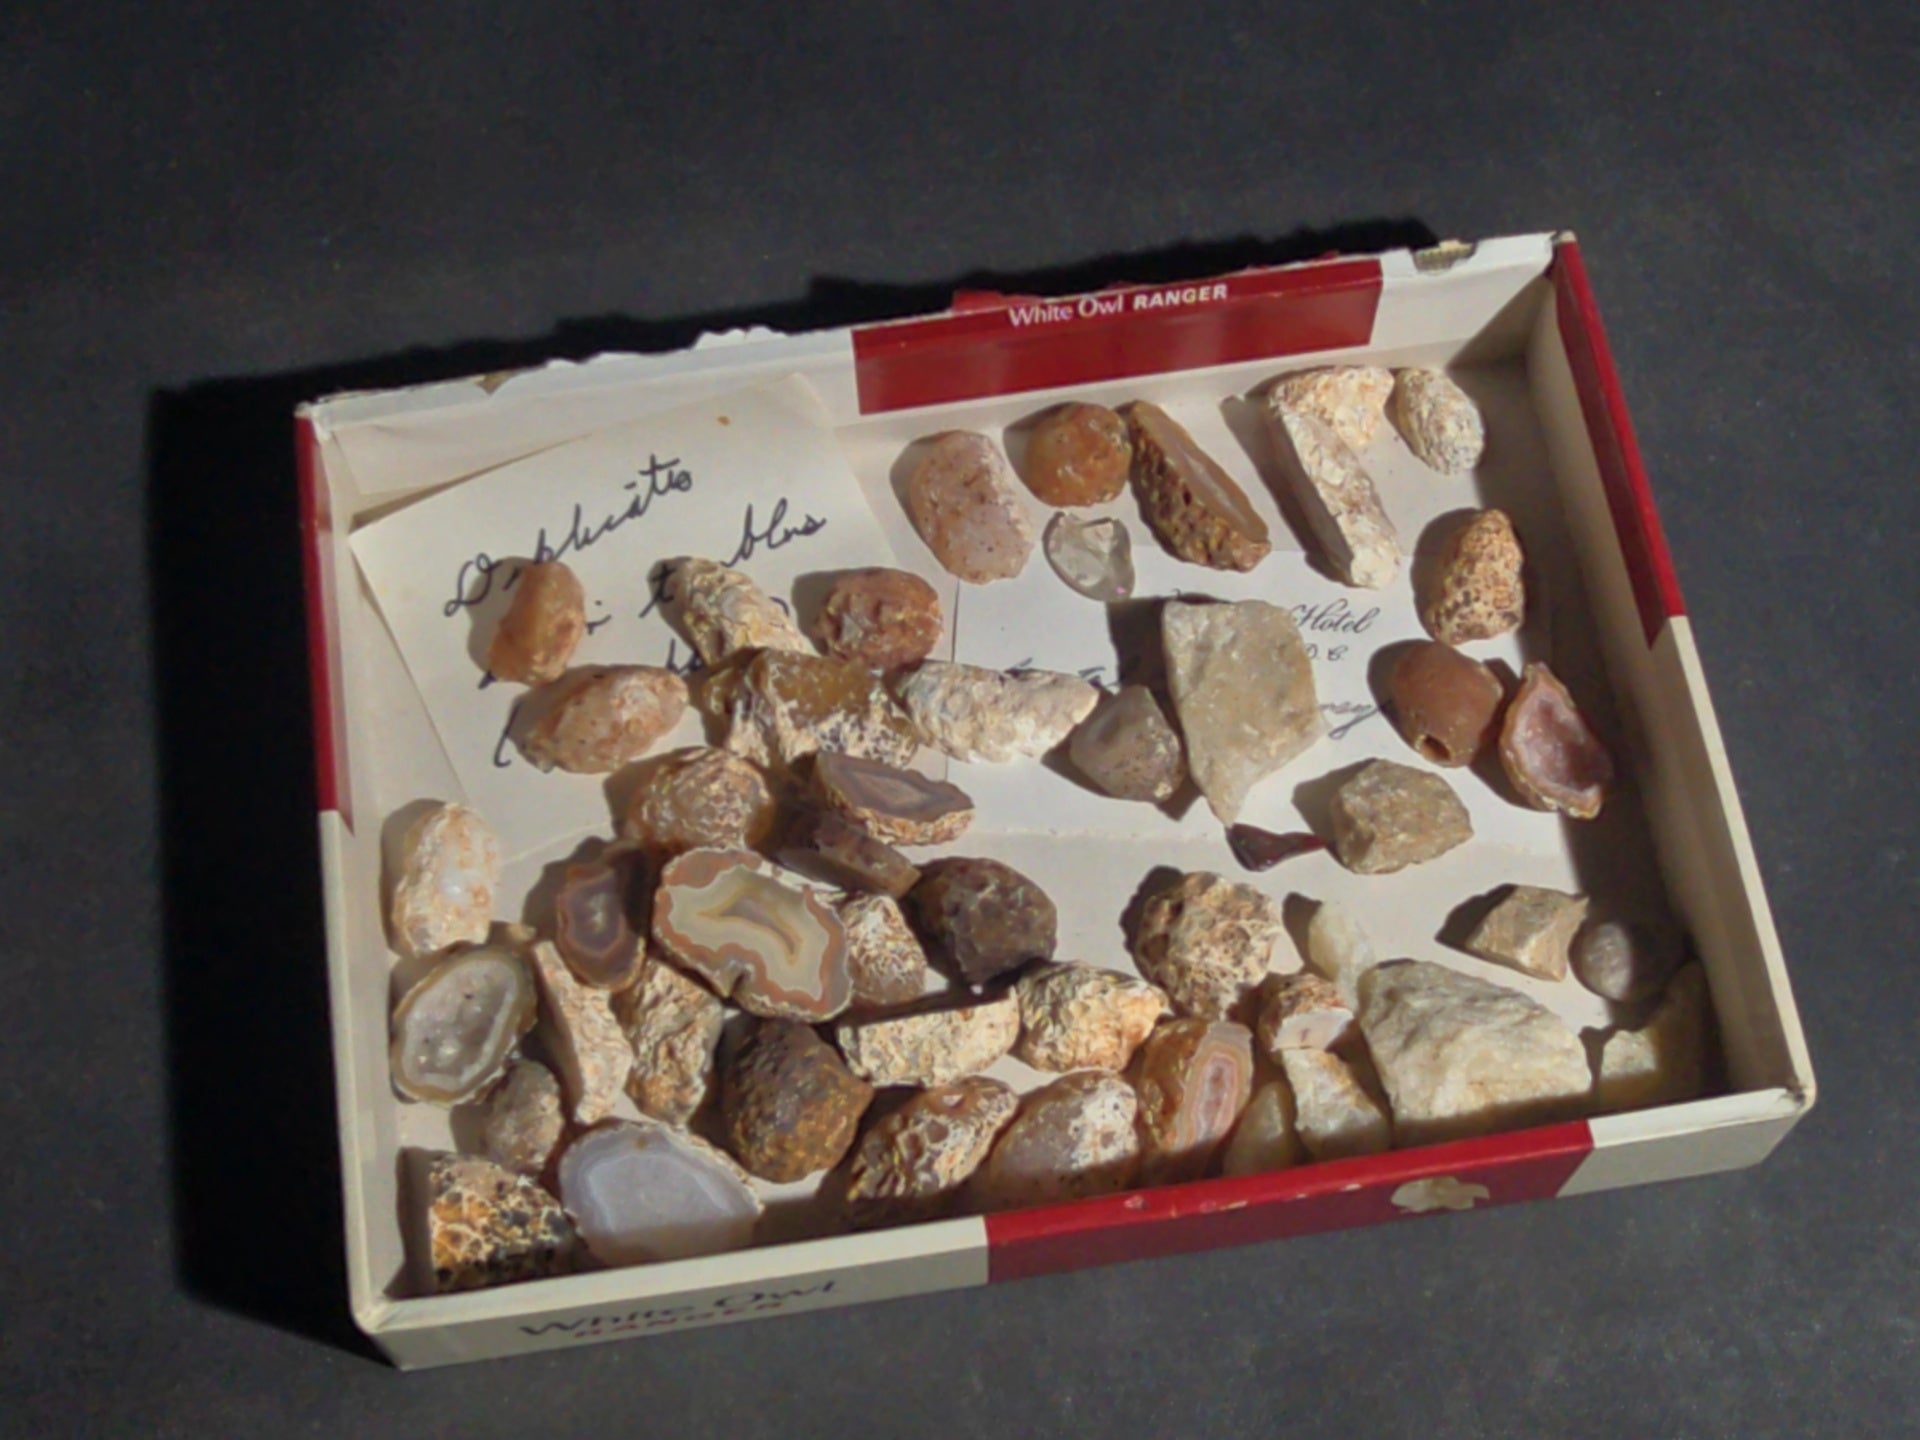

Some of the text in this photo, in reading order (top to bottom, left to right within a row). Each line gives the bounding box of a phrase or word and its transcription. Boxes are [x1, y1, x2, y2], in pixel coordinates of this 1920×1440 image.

[1008, 284, 1228, 327] White Owl RANGER
[1291, 598, 1381, 633] Hotel
[519, 1281, 836, 1335] White Owl
